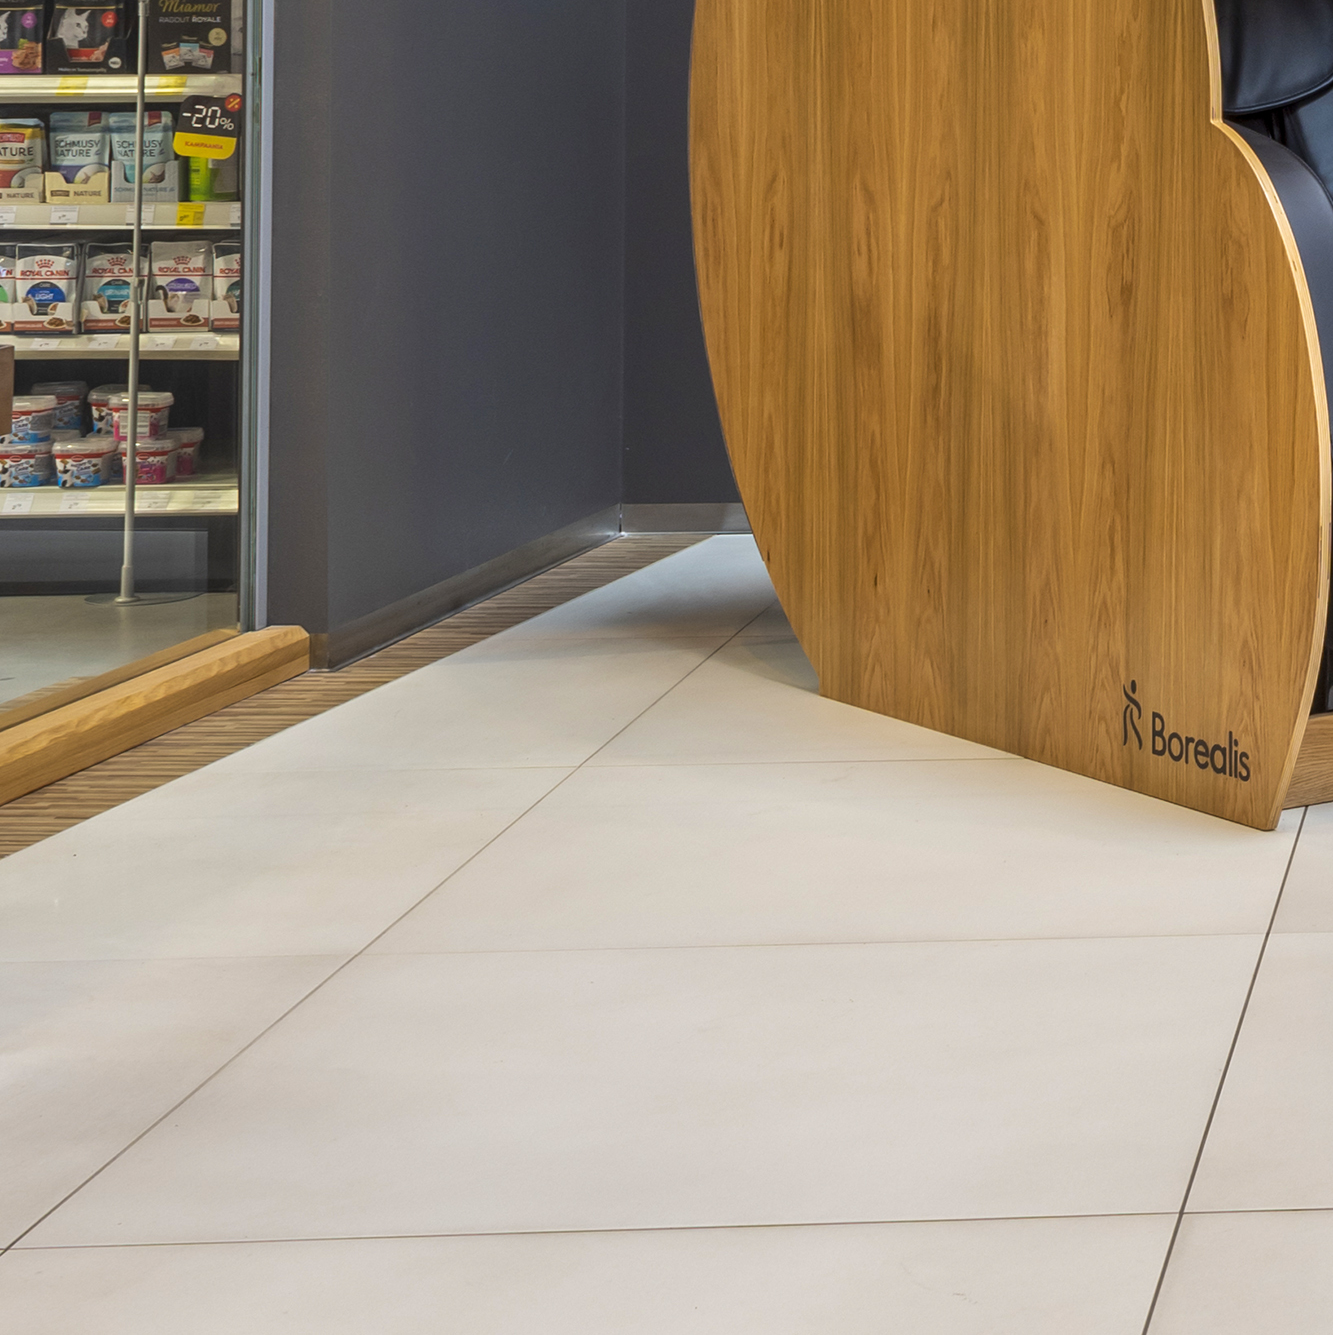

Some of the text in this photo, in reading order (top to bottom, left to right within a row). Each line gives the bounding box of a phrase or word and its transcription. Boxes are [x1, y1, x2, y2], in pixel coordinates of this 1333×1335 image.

[182, 104, 235, 131] -20%
[54, 139, 101, 149] SCHMUSY
[116, 139, 165, 149] SCHUSY
[0, 146, 34, 157] ATURE
[118, 148, 156, 158] NATRE
[73, 190, 102, 198] NATURE
[20, 269, 43, 277] ROYAL
[44, 269, 71, 277] CANIN
[92, 267, 117, 275] ROYAL
[157, 266, 206, 274] ROYAL CANIN
[219, 267, 240, 275] ROYA
[1151, 710, 1251, 783] Borealis
